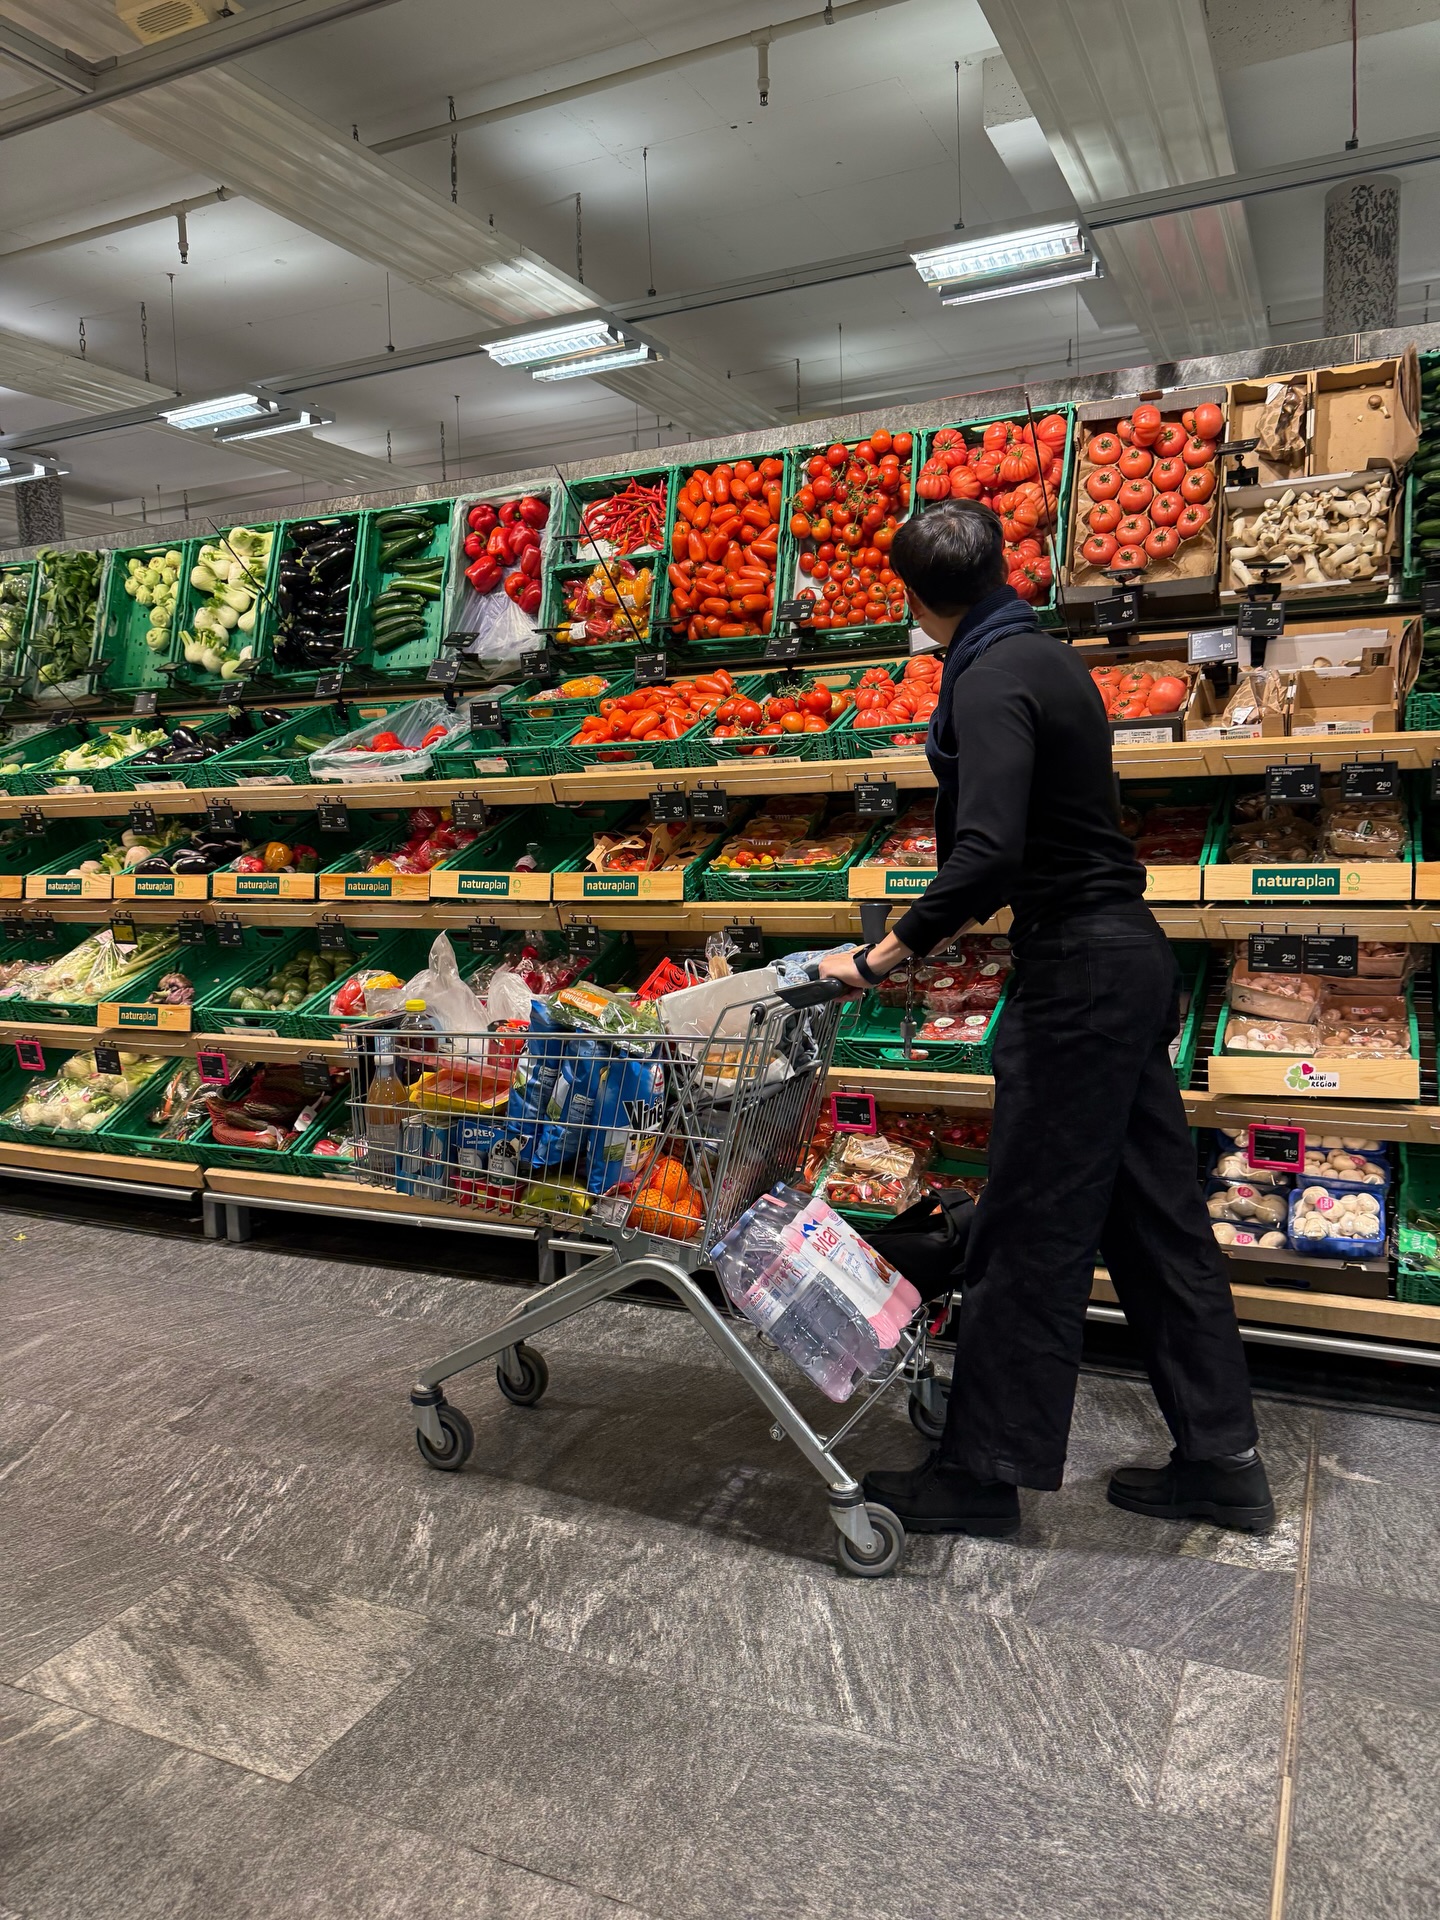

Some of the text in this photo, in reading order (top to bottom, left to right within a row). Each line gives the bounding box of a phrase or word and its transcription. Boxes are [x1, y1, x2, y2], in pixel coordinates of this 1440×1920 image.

[48, 881, 81, 892] naturaplan
[137, 882, 173, 892] naturaplan
[238, 880, 278, 891] naturaplan
[347, 880, 390, 892] naturaplan
[461, 880, 507, 891] naturaplan
[586, 880, 636, 892] naturaplan
[1257, 874, 1335, 890] naturaplan
[121, 1011, 156, 1022] naturaplan
[464, 1128, 495, 1138] OREO
[812, 1226, 842, 1257] evian
